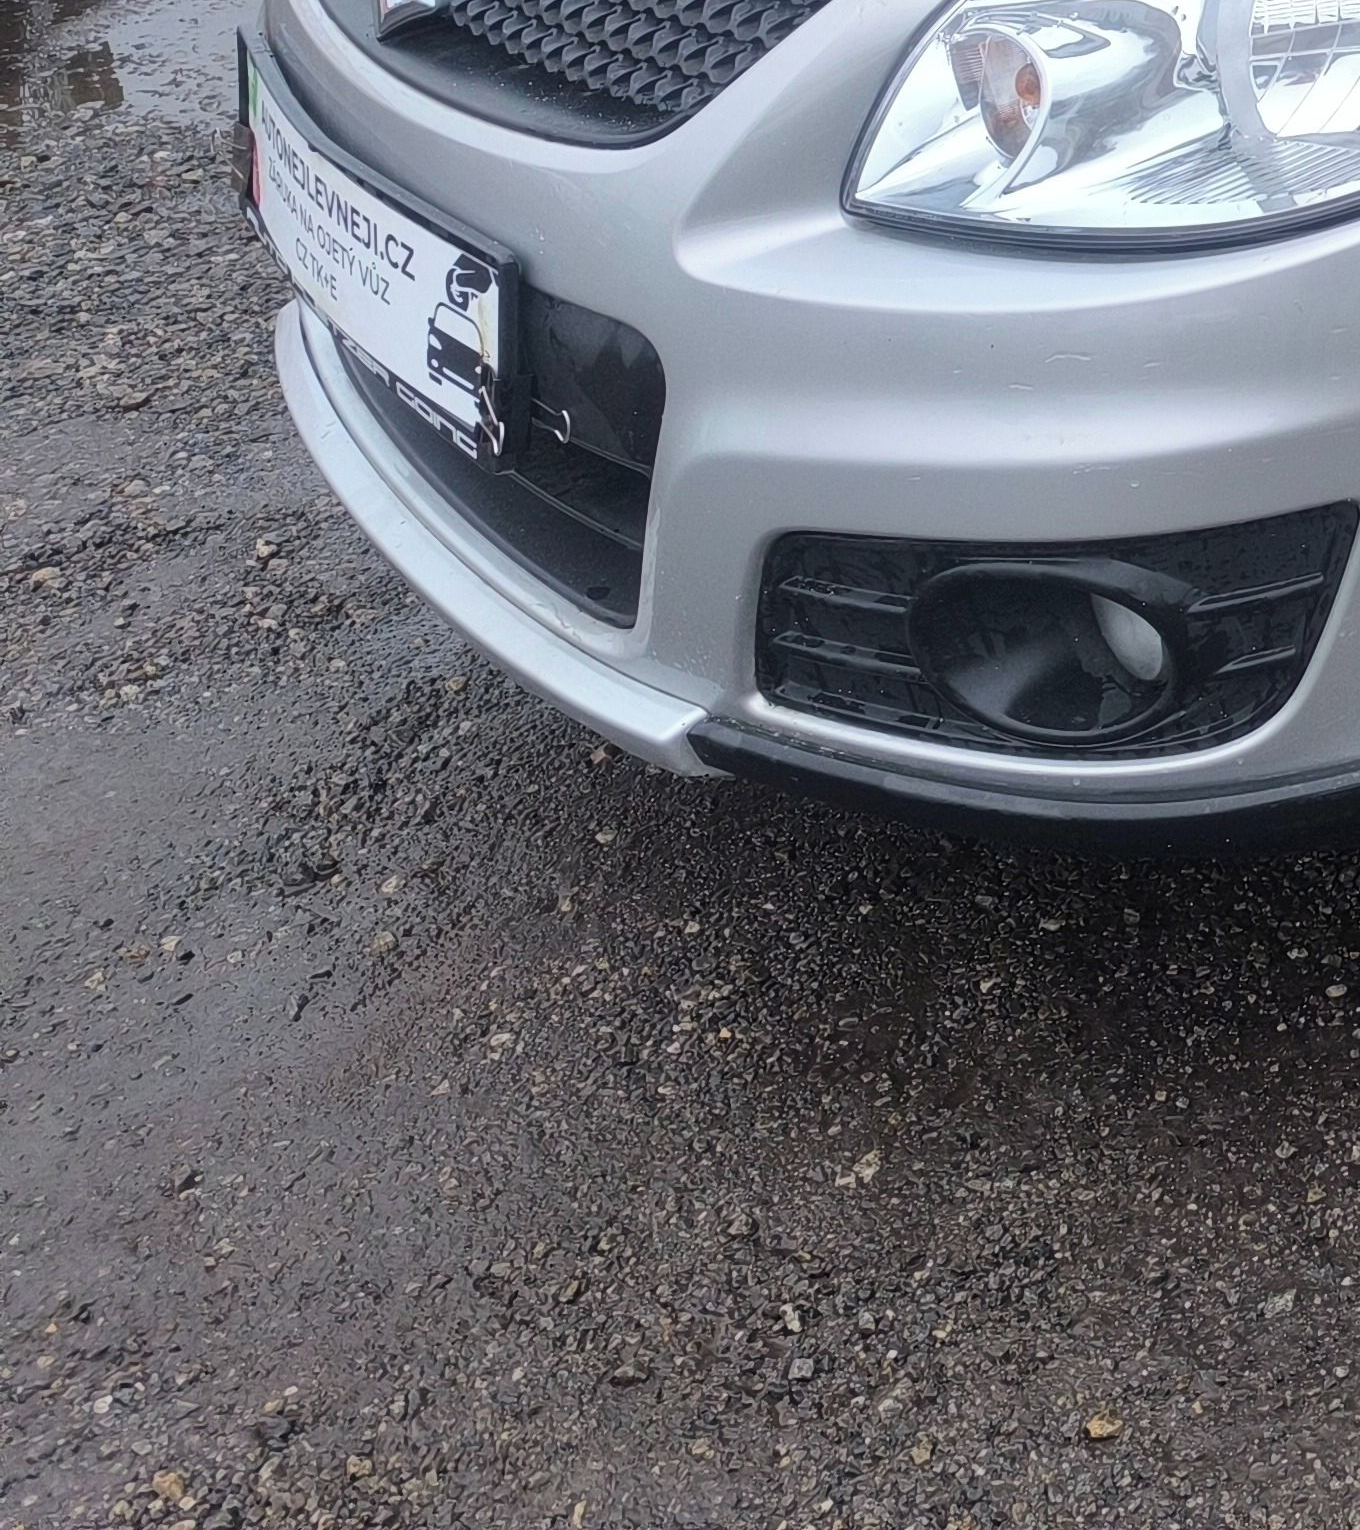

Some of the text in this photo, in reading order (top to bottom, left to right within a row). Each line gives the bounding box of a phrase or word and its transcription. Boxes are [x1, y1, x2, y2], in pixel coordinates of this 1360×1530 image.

[261, 100, 416, 282] AUTONEJLEVNEJI.CZ
[296, 238, 338, 302] CZ TK+E
[300, 203, 315, 241] NA
[317, 224, 356, 277] OJETÝ
[358, 260, 391, 306] VŮZ
